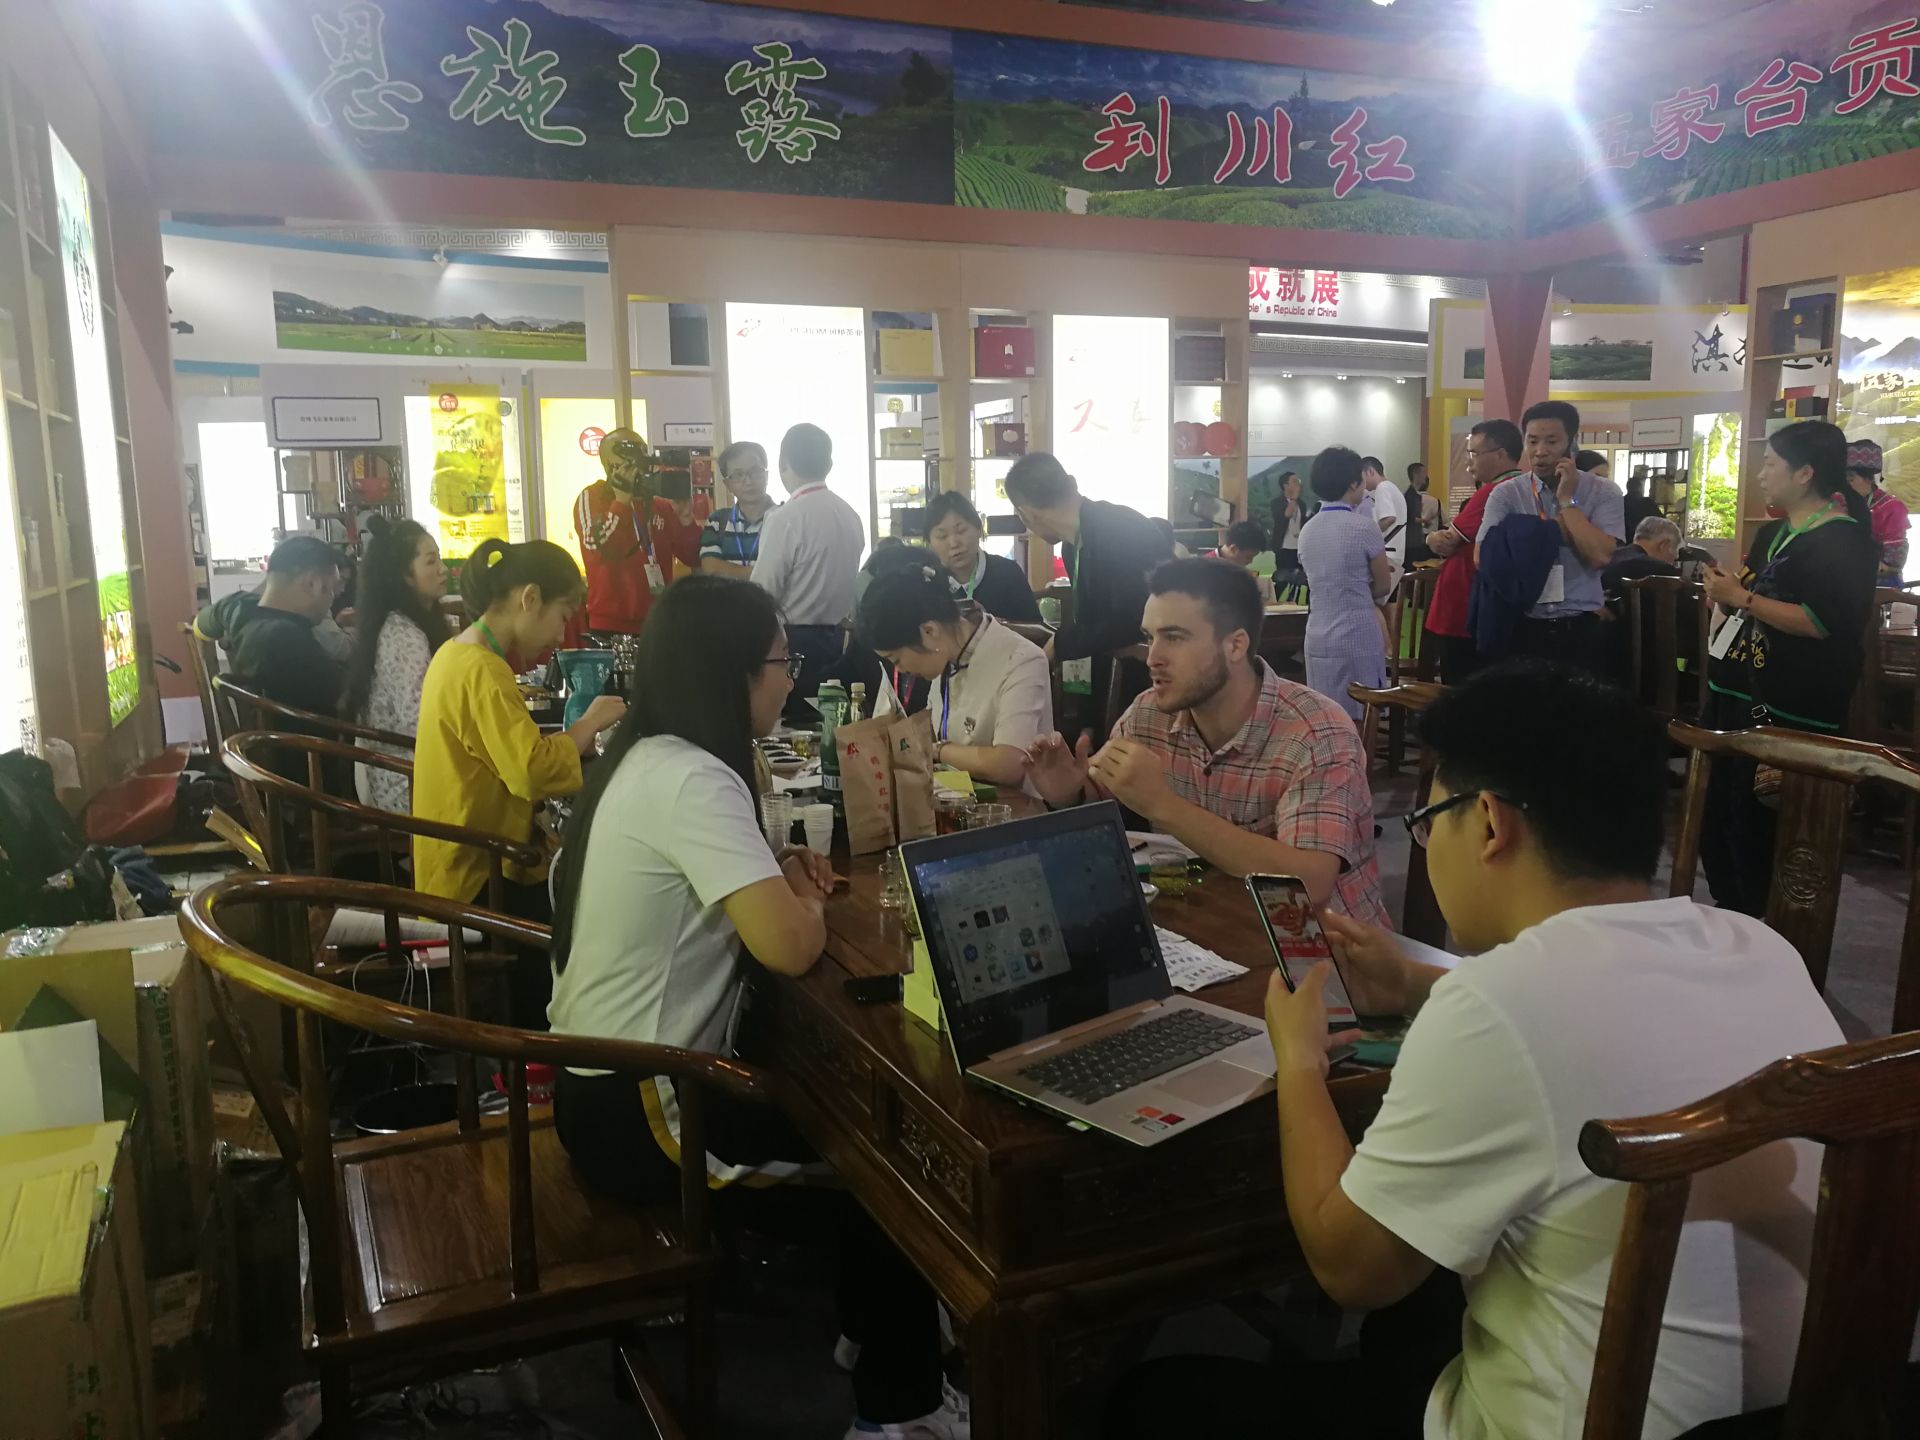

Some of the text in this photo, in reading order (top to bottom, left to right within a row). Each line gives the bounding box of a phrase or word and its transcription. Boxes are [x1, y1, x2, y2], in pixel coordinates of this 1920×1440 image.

[307, 2, 842, 164] 恩施玉露
[1082, 91, 1416, 200] 利川红
[1274, 304, 1305, 316] Republic
[1308, 307, 1316, 315] of
[1317, 308, 1338, 317] China
